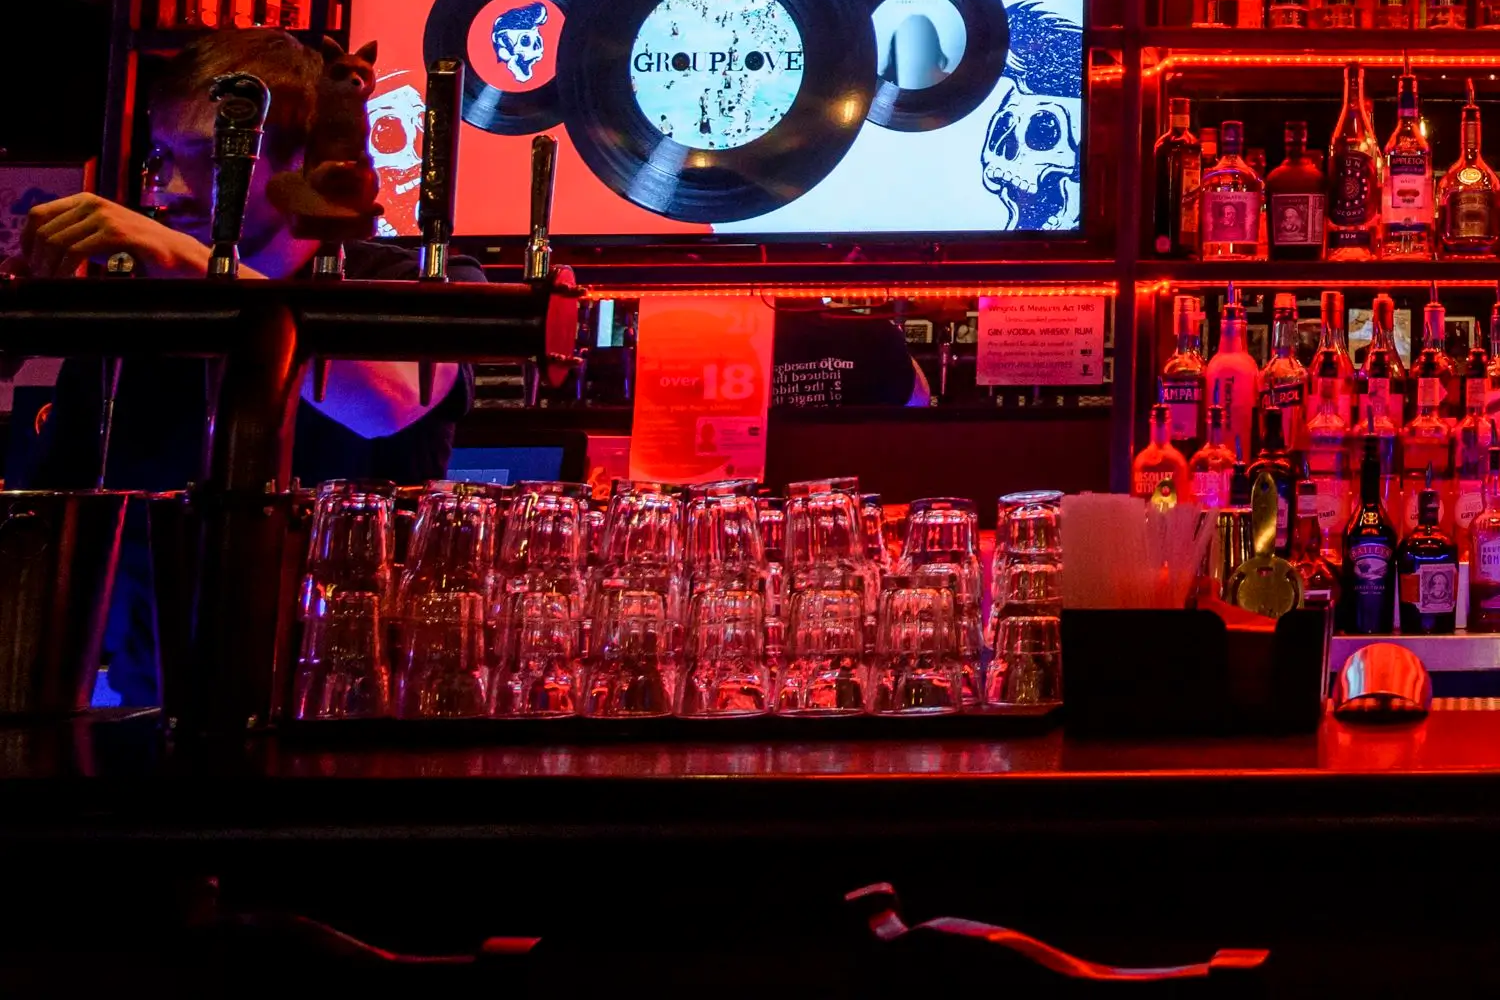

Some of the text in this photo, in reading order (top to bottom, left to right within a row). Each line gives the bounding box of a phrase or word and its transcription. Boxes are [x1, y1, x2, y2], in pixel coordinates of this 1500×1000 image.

[633, 51, 804, 73] GROUPLOVE
[659, 376, 700, 387] over
[702, 363, 755, 400] 18
